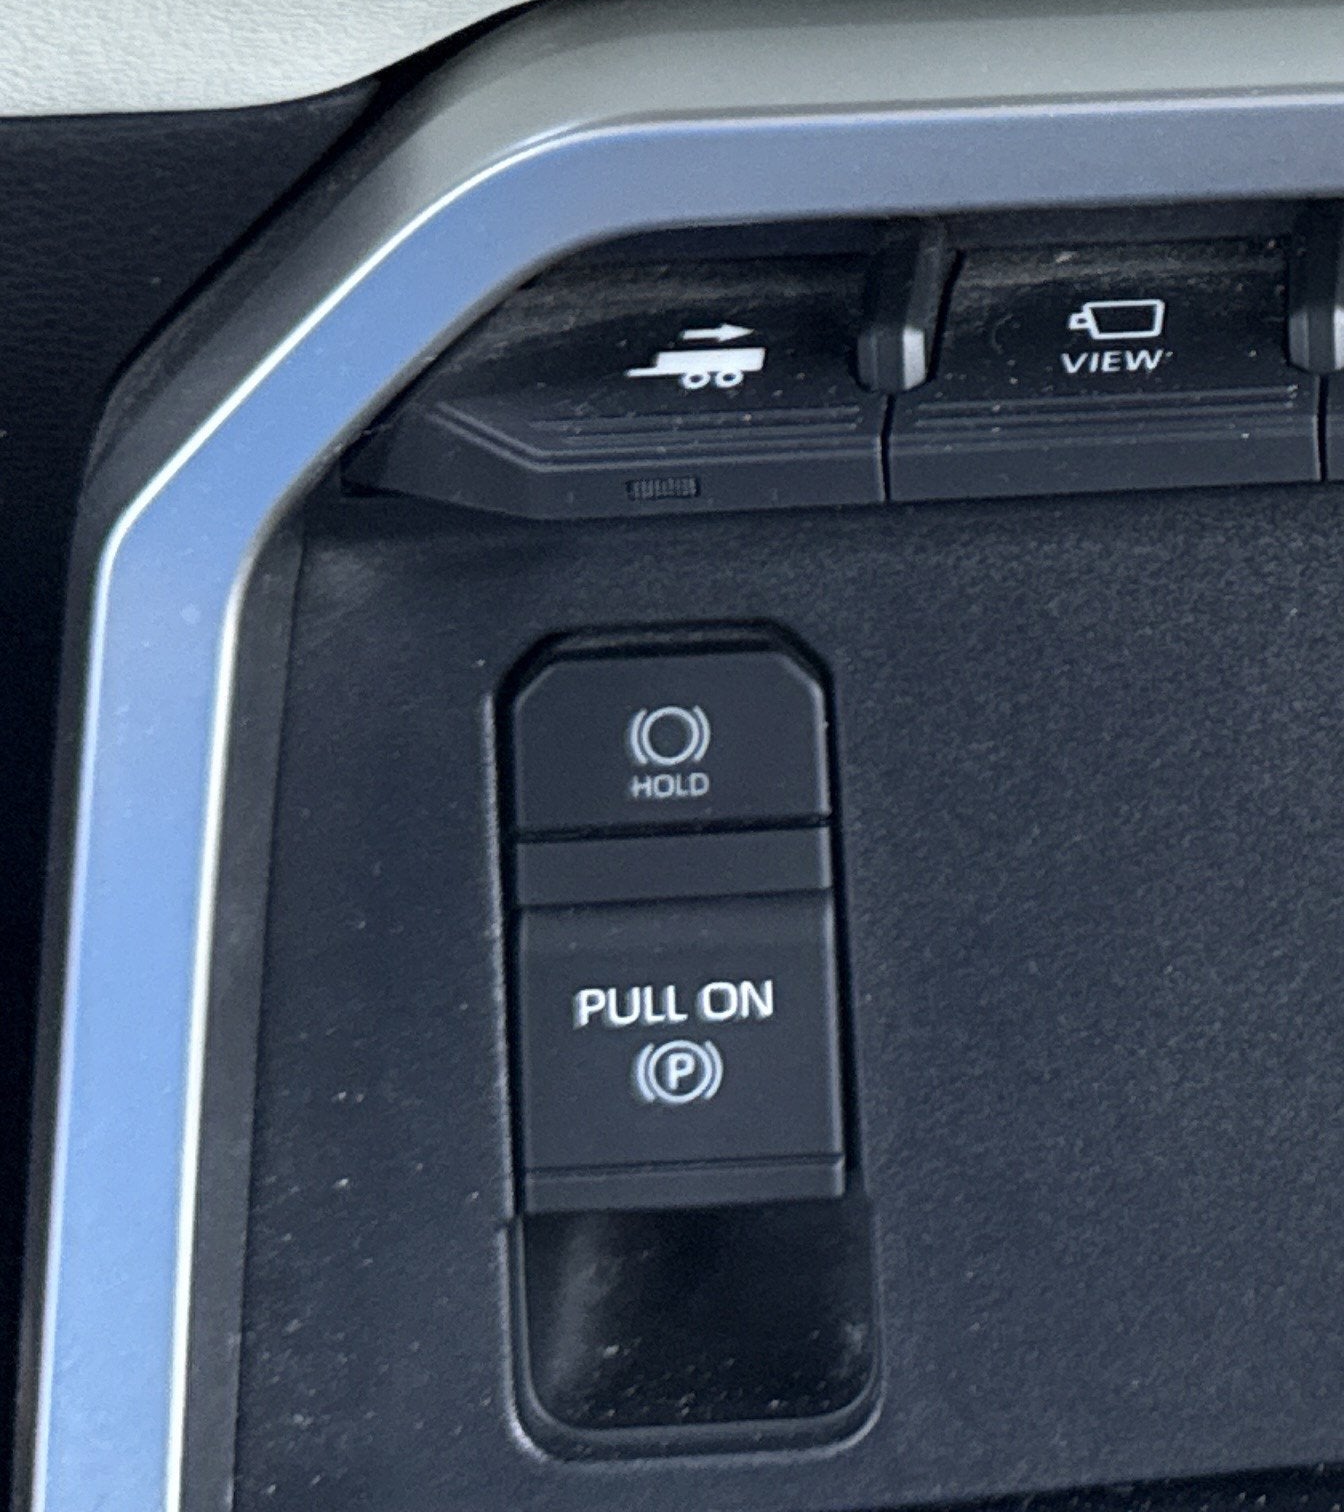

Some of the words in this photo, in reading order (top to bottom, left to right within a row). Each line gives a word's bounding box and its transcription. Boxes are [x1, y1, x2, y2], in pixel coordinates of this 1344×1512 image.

[1061, 350, 1162, 374] VIEW
[630, 772, 709, 798] HOLD
[573, 985, 688, 1028] PULL
[699, 980, 774, 1021] ON
